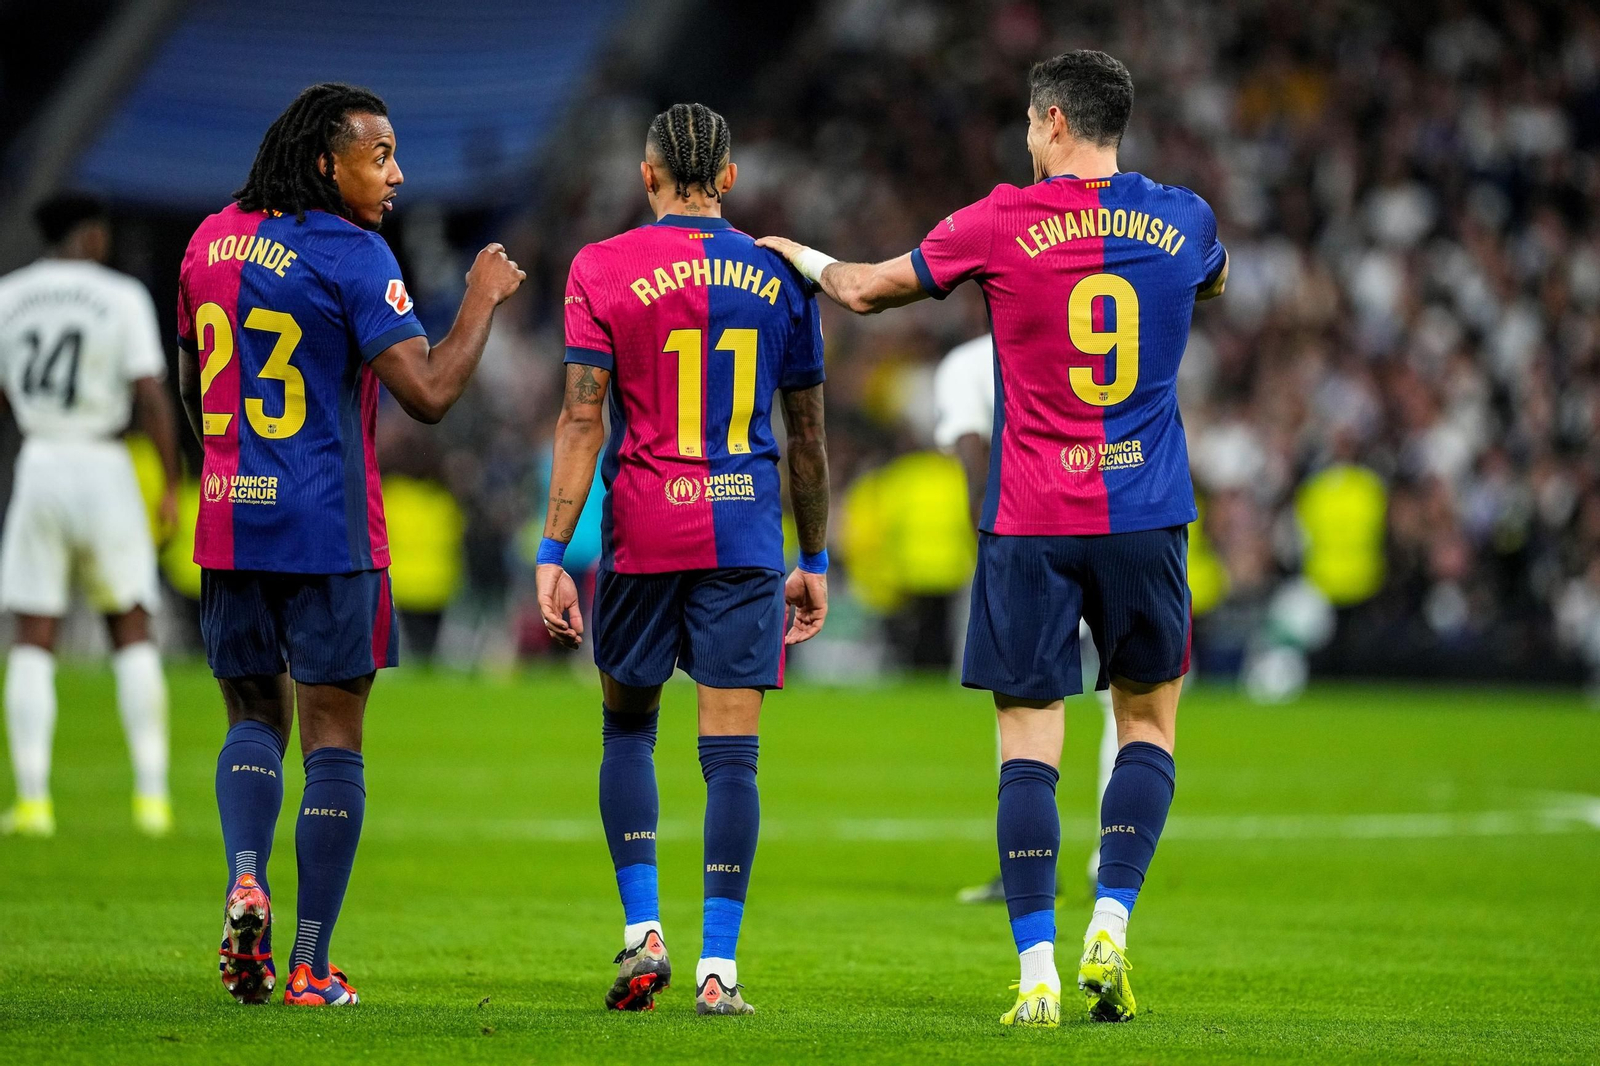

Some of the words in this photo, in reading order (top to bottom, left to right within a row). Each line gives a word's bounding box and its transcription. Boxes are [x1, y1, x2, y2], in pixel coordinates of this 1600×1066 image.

[1015, 207, 1186, 258] LEWANDOWSKI
[208, 235, 298, 278] KOUNDE
[630, 258, 782, 306] RAPHINHA
[1067, 273, 1140, 407] 9
[195, 301, 307, 440] 23
[662, 328, 758, 458] 11
[1098, 440, 1142, 455] UNHCR
[1098, 451, 1145, 467] ACNUR
[228, 486, 277, 500] ACNUR
[230, 475, 278, 488] UNHCR
[703, 473, 753, 486] UNHCR
[704, 484, 755, 497] ACNUR
